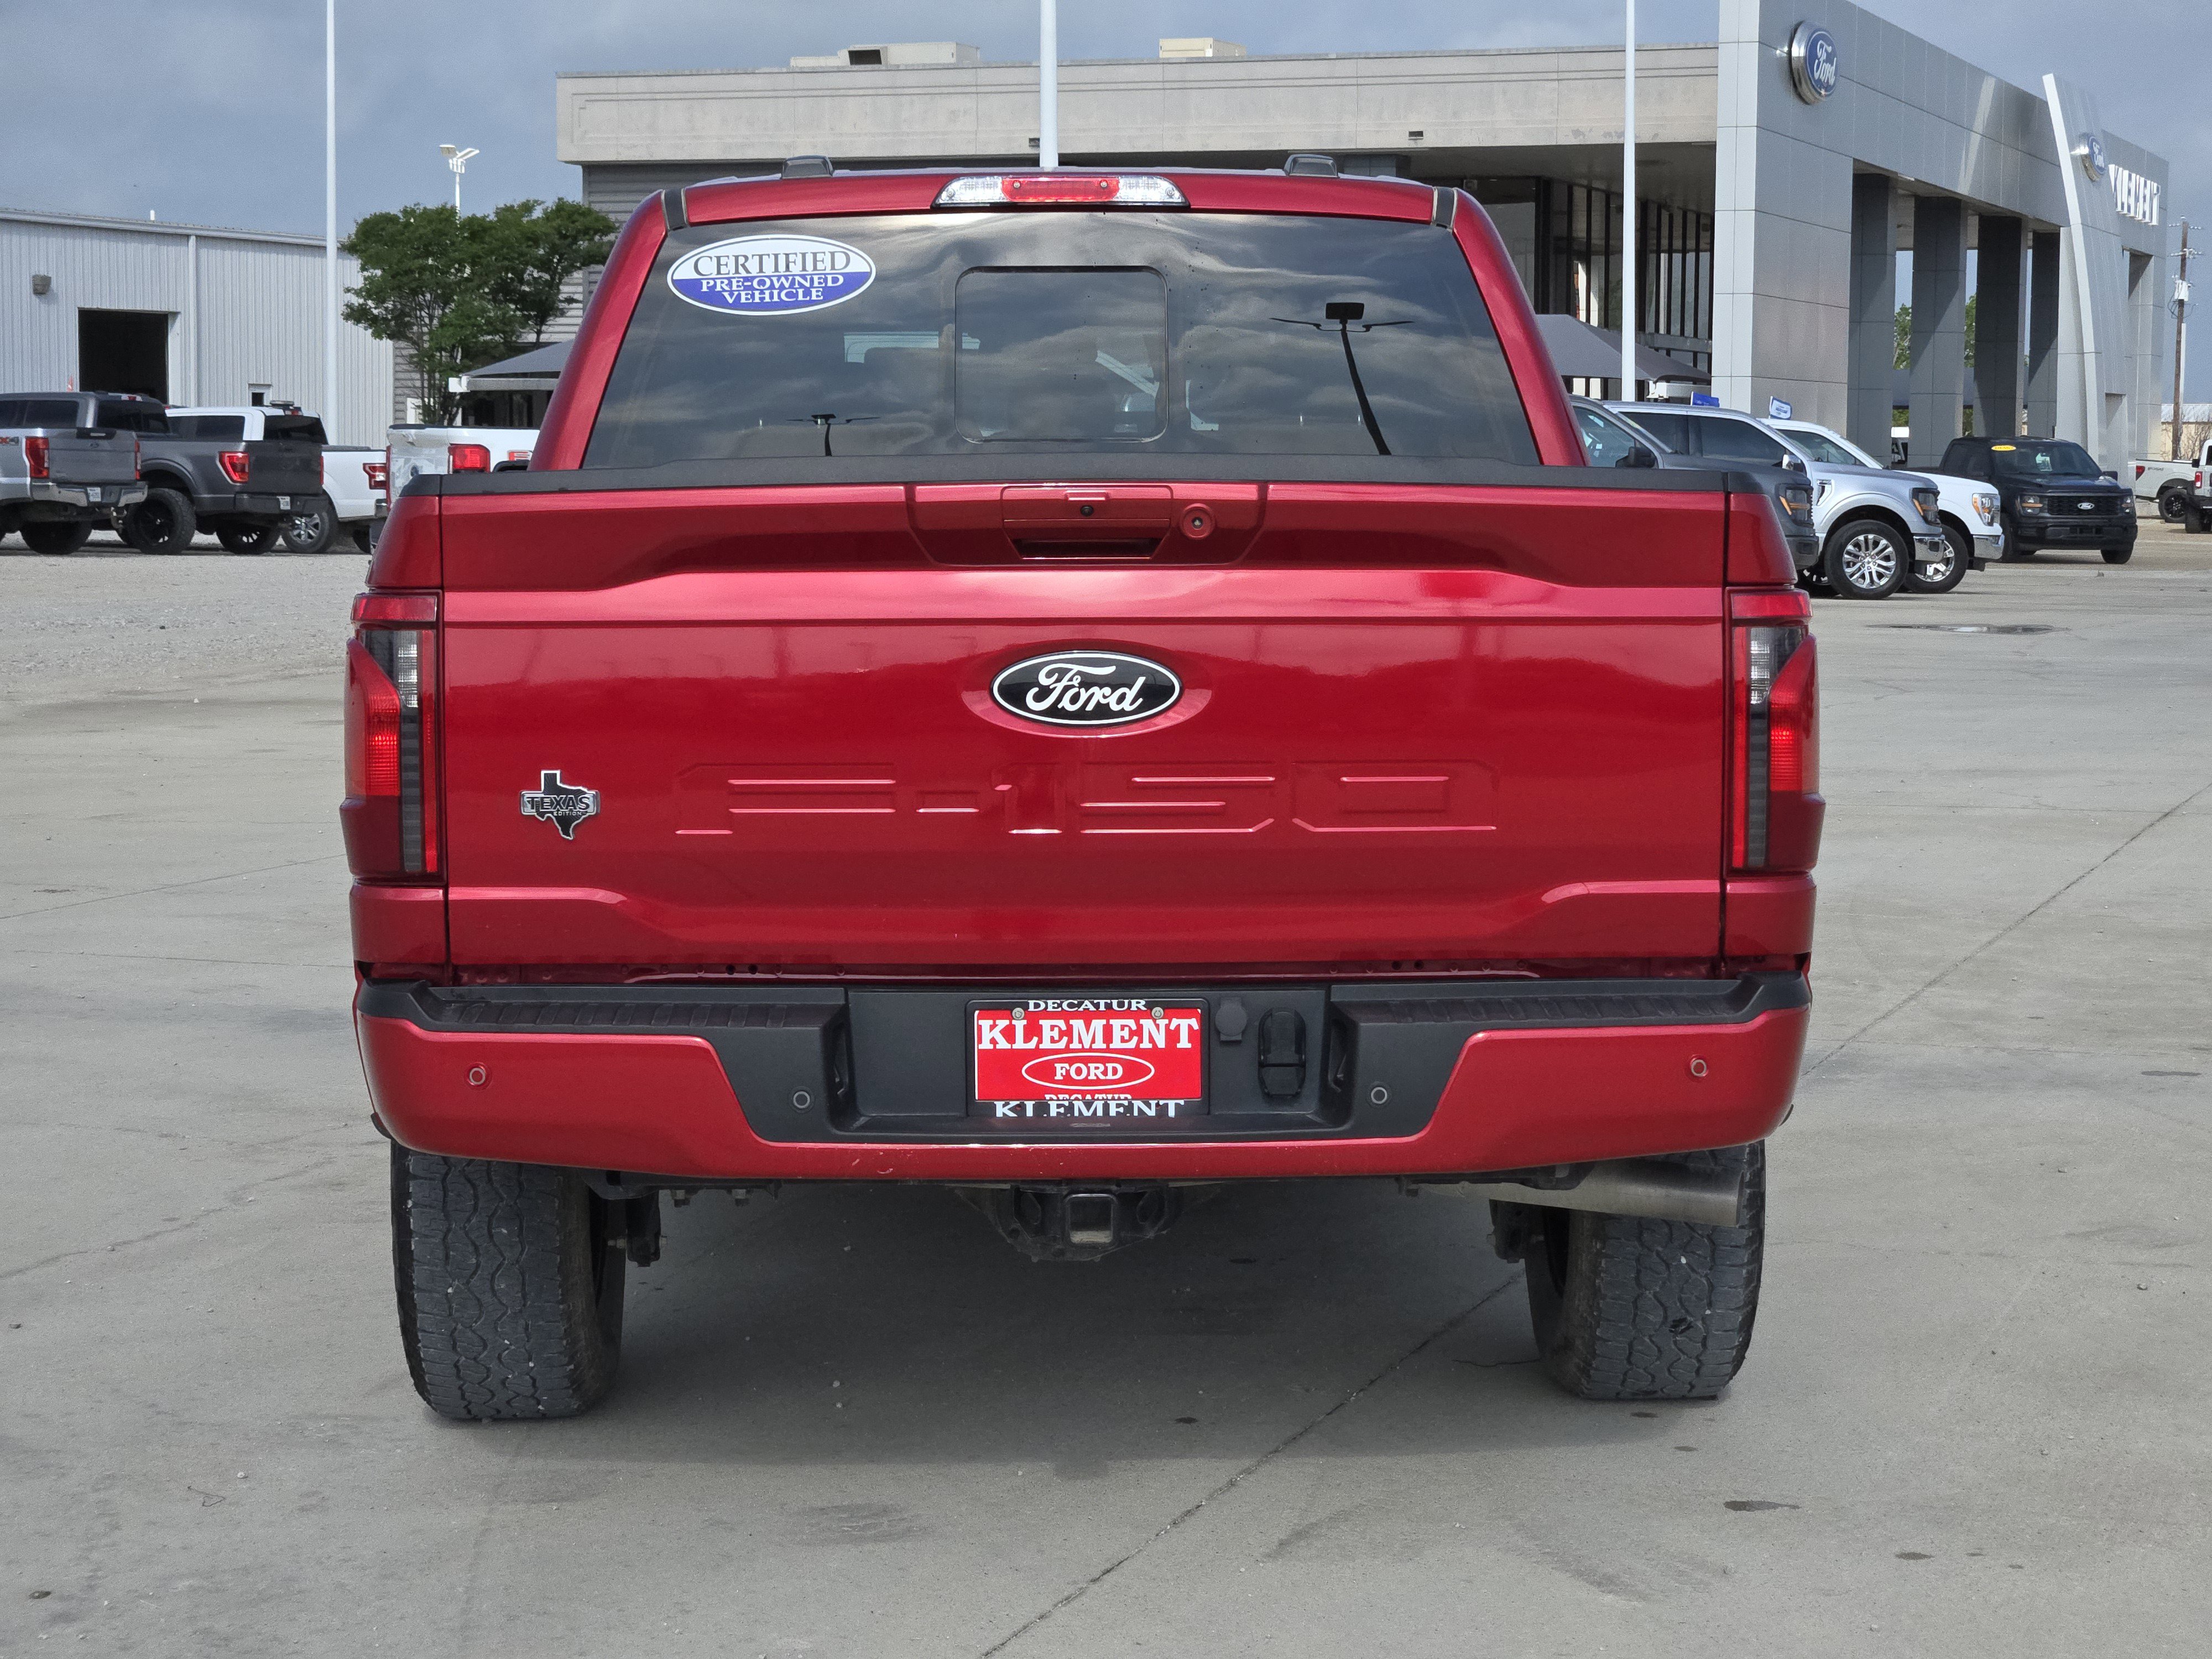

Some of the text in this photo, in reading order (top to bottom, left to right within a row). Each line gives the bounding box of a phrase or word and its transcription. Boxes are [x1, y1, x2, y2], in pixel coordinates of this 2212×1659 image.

[1814, 40, 1837, 86] Ford
[693, 251, 850, 276] CERTIFIED
[701, 275, 844, 291] PRE-OWNED
[722, 289, 823, 304] VEHICLE
[1026, 664, 1146, 711] Ford
[526, 796, 591, 811] TEXAS
[1027, 1000, 1147, 1011] DECATUR
[978, 1018, 1199, 1050] KLEMENT
[1054, 1063, 1124, 1080] FORD
